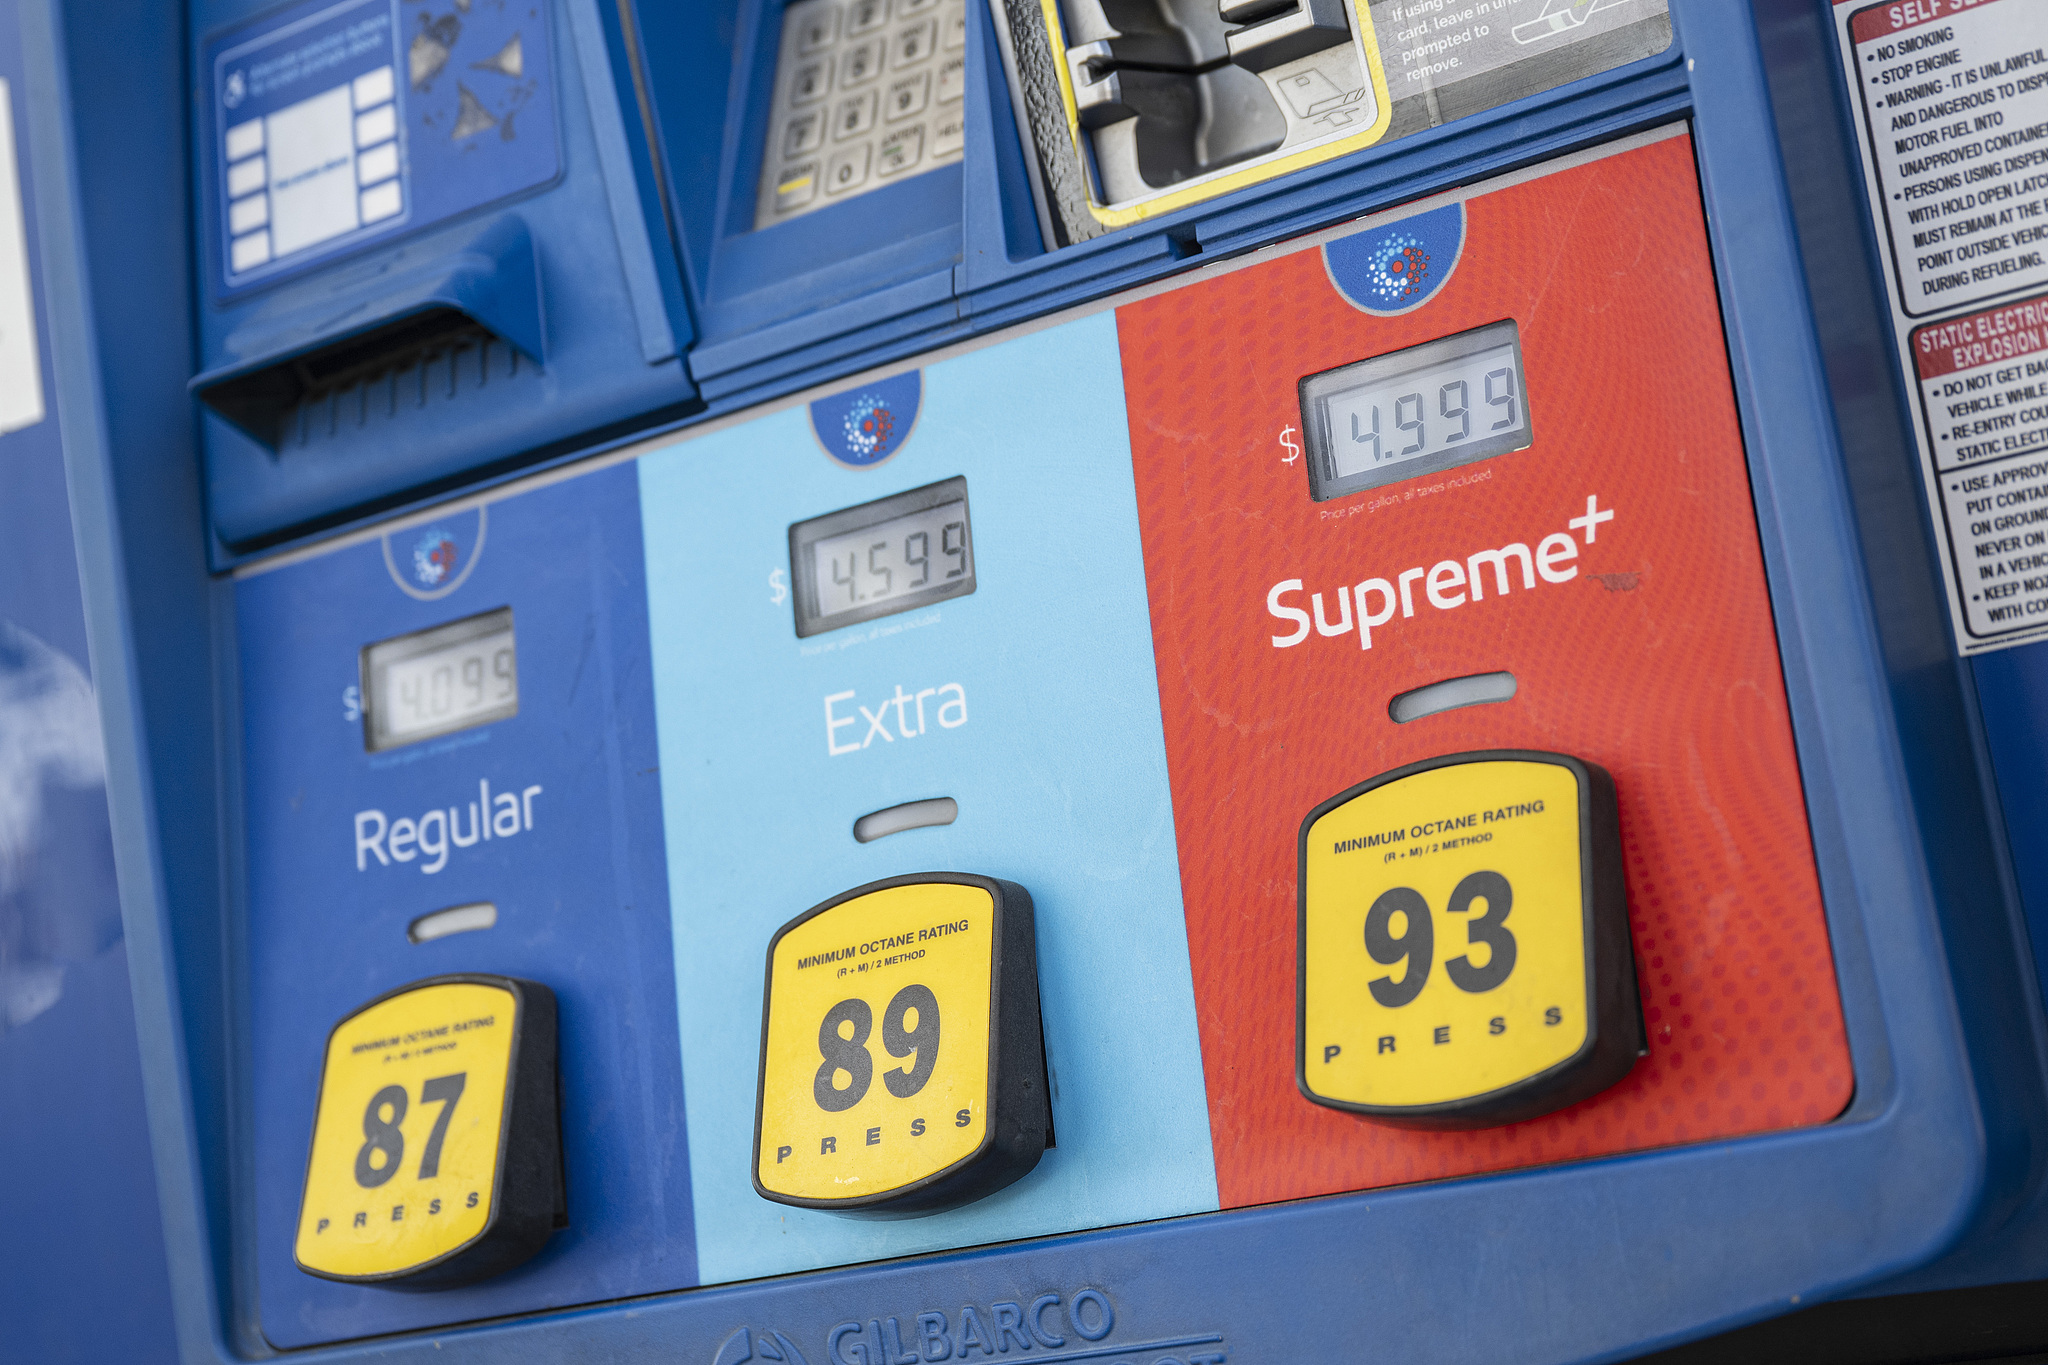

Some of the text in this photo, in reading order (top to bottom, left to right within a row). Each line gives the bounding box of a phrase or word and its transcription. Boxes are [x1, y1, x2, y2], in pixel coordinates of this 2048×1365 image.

[1392, 0, 1443, 22] If using
[1398, 21, 1432, 42] card,
[1434, 9, 1473, 29] leave
[1476, 3, 1489, 15] in
[1402, 25, 1490, 65] prompted to
[1877, 26, 1954, 62] NO SMOKING
[1406, 57, 1463, 82] remove.
[1882, 49, 1962, 85] STOP ENGINE
[1885, 79, 1943, 108] WARNING
[1951, 73, 1962, 89] IT
[1966, 69, 1978, 84] IS
[1980, 48, 2048, 80] UNLAWFUL
[1891, 112, 1916, 132] AND
[1918, 88, 1996, 123] DANGEROUS
[1997, 83, 2015, 99] TO
[1895, 111, 2004, 155] MOTOR FUEL INTO
[1899, 142, 1982, 177] UNAPPROVED
[1904, 173, 1962, 201] PERSONS
[1964, 161, 2002, 184] USING
[1908, 204, 1940, 225] WITH
[1941, 194, 1976, 216] HOLD
[1978, 184, 2013, 206] OPEN
[1913, 226, 1946, 248] MUST
[1950, 213, 1997, 239] REMAIN
[2000, 208, 2013, 225] AT
[2016, 201, 2043, 220] THE
[1917, 249, 1953, 272] POINT
[1957, 234, 2011, 261] OUTSIDE
[1922, 251, 2046, 296] DURING REFUELING.
[1919, 321, 1973, 353] STATIC
[1953, 328, 2041, 369] EXPLOSION
[1943, 381, 1963, 397] DO
[1966, 373, 1993, 392] NOT
[1996, 366, 2022, 384] GET
[1947, 382, 2048, 418] VEHICLE WHILE
[1350, 366, 1516, 462] 4.999
[1952, 412, 2016, 440] RE-ENTRY
[1279, 424, 1300, 465] $
[1957, 440, 2001, 462] STATIC
[1319, 509, 1346, 521] Price
[1348, 504, 1364, 517] per
[1404, 488, 1414, 500] all
[1417, 482, 1445, 497] taxes
[1447, 470, 1492, 490] included
[1962, 475, 1990, 493] USE
[1966, 497, 1993, 515] PUT
[1971, 520, 1992, 536] ON
[1975, 535, 2022, 558] NEVER
[2025, 530, 2045, 546] ON
[832, 521, 966, 601] 4.599
[1979, 563, 1994, 580] IN
[1997, 562, 2006, 576] A
[769, 567, 787, 606] $
[1983, 581, 2020, 601] KEEP
[1987, 603, 2023, 622] WITH
[824, 680, 968, 756] Extra
[355, 778, 543, 874] Regular
[1334, 800, 1545, 855] MINIMUM OCTANE RATING
[1384, 852, 1396, 864] (R
[1409, 844, 1423, 857] M)
[1432, 844, 1439, 853] 2
[1442, 832, 1493, 851] METHOD
[797, 919, 969, 970] MINIMUM OCTANE RATING
[1364, 870, 1518, 1008] 93
[837, 968, 847, 979] (R
[858, 962, 868, 973] M)
[876, 960, 881, 968] 2
[884, 949, 926, 966] METHOD
[813, 984, 941, 1112] 89
[354, 1072, 467, 1189] 87
[828, 1288, 1115, 1365] GILBARCO
